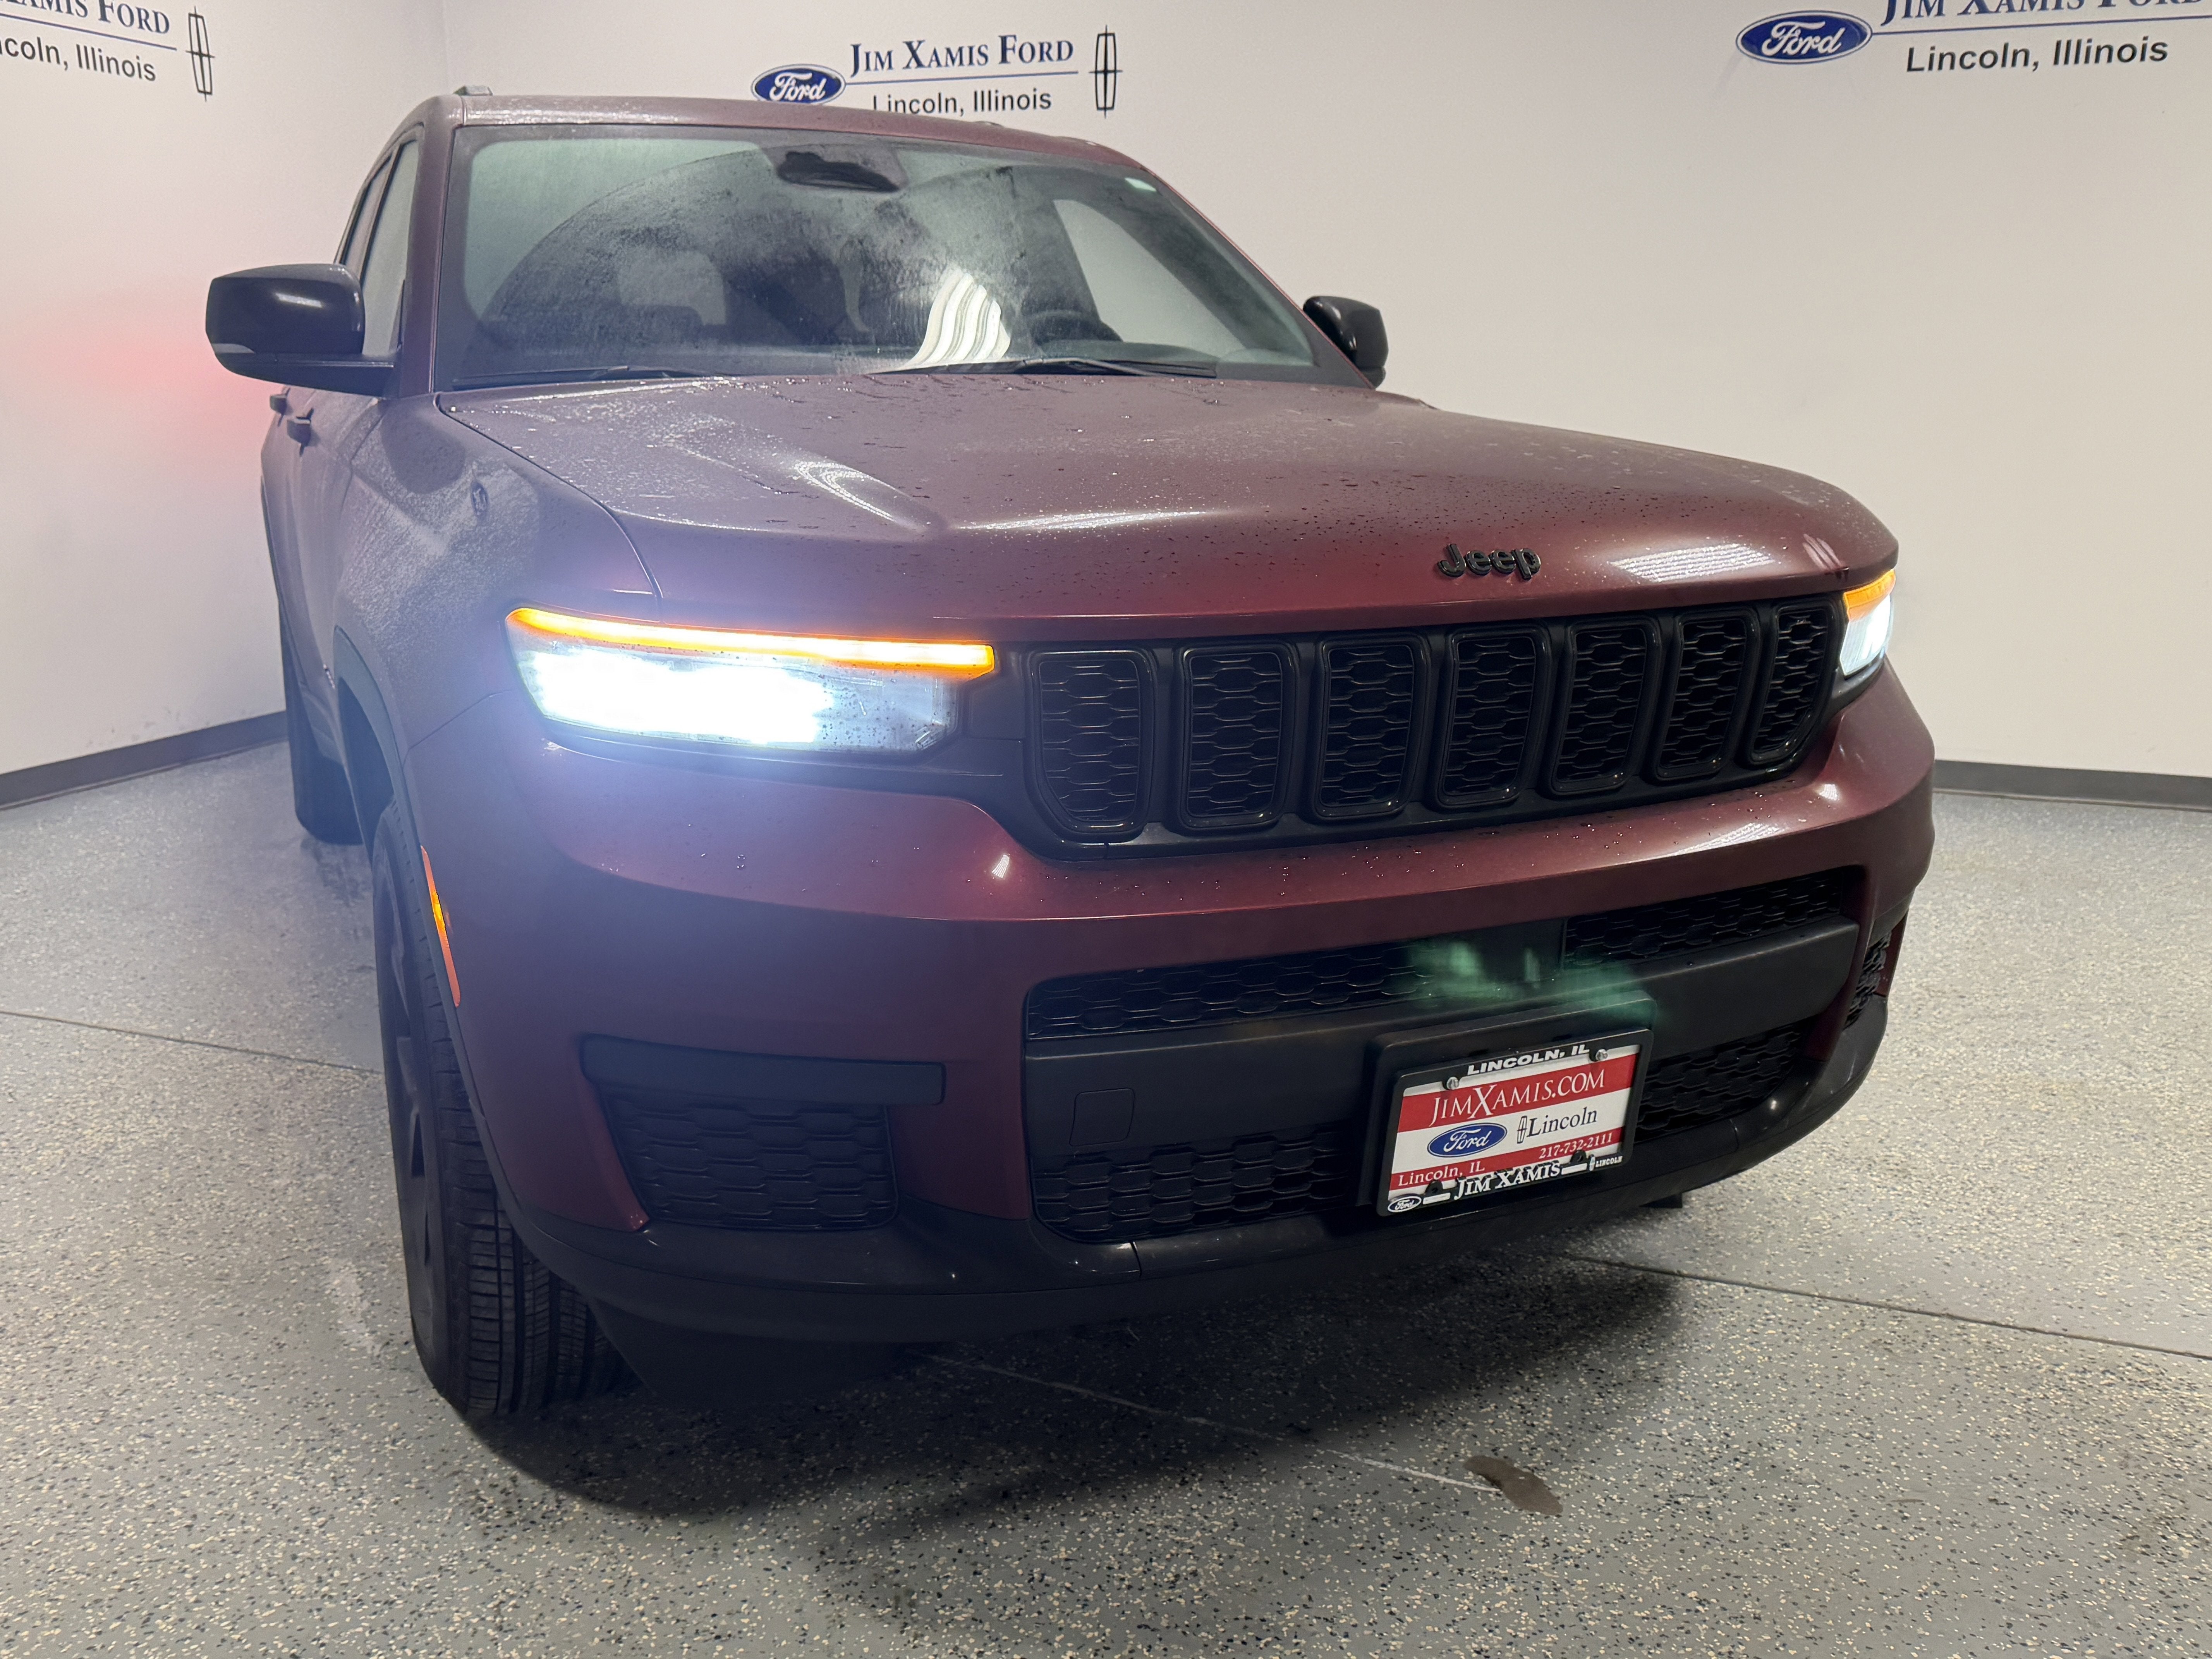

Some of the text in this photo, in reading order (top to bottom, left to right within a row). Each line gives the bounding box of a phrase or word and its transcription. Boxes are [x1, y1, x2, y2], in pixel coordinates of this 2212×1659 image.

[98, 0, 170, 34] FORD
[1762, 21, 1846, 57] Ford
[1906, 36, 2168, 72] Lincoln, Illinois
[0, 36, 156, 82] coln, Illinois
[850, 34, 1073, 77] JIM XAMIS FORD
[769, 72, 827, 101] Ford
[974, 88, 1051, 112] Illinois
[1437, 543, 1541, 580] Jeep
[1467, 1044, 1590, 1076] LINCOLN, IL
[1429, 1069, 1605, 1127] JIMXAMIS.COM
[1526, 1106, 1597, 1138] Lincoln
[1443, 1128, 1492, 1152] Ford
[1539, 1133, 1613, 1159] 217-732-2111
[1398, 1161, 1485, 1187] Lincoln, IL
[1595, 1156, 1623, 1168] LINCOLN
[1453, 1163, 1561, 1200] JIM XAMIS
[1395, 1199, 1416, 1210] Ford
